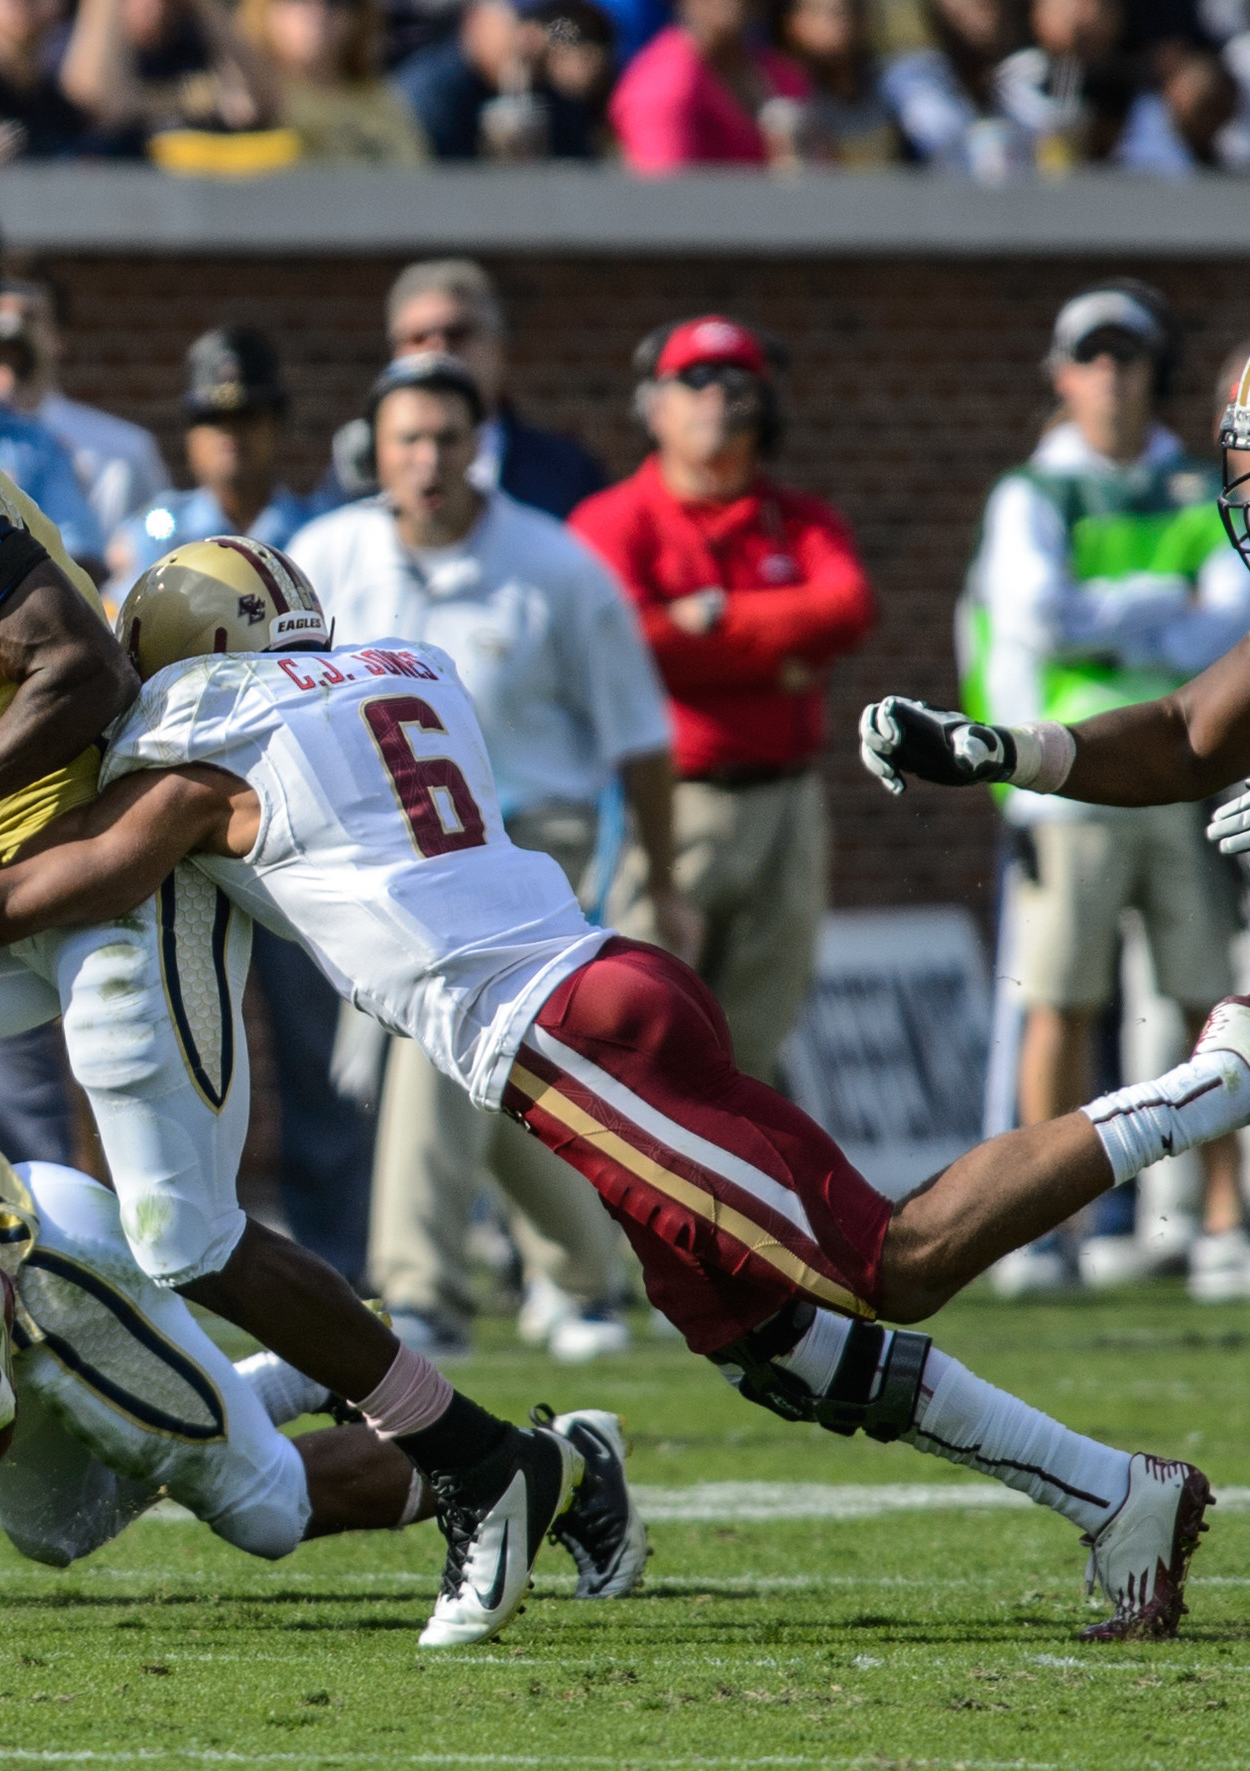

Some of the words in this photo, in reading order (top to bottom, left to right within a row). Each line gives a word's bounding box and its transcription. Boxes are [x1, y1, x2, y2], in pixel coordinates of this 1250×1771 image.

[278, 617, 322, 634] EAGLES
[278, 655, 356, 691] C.J.
[359, 693, 488, 859] 6
